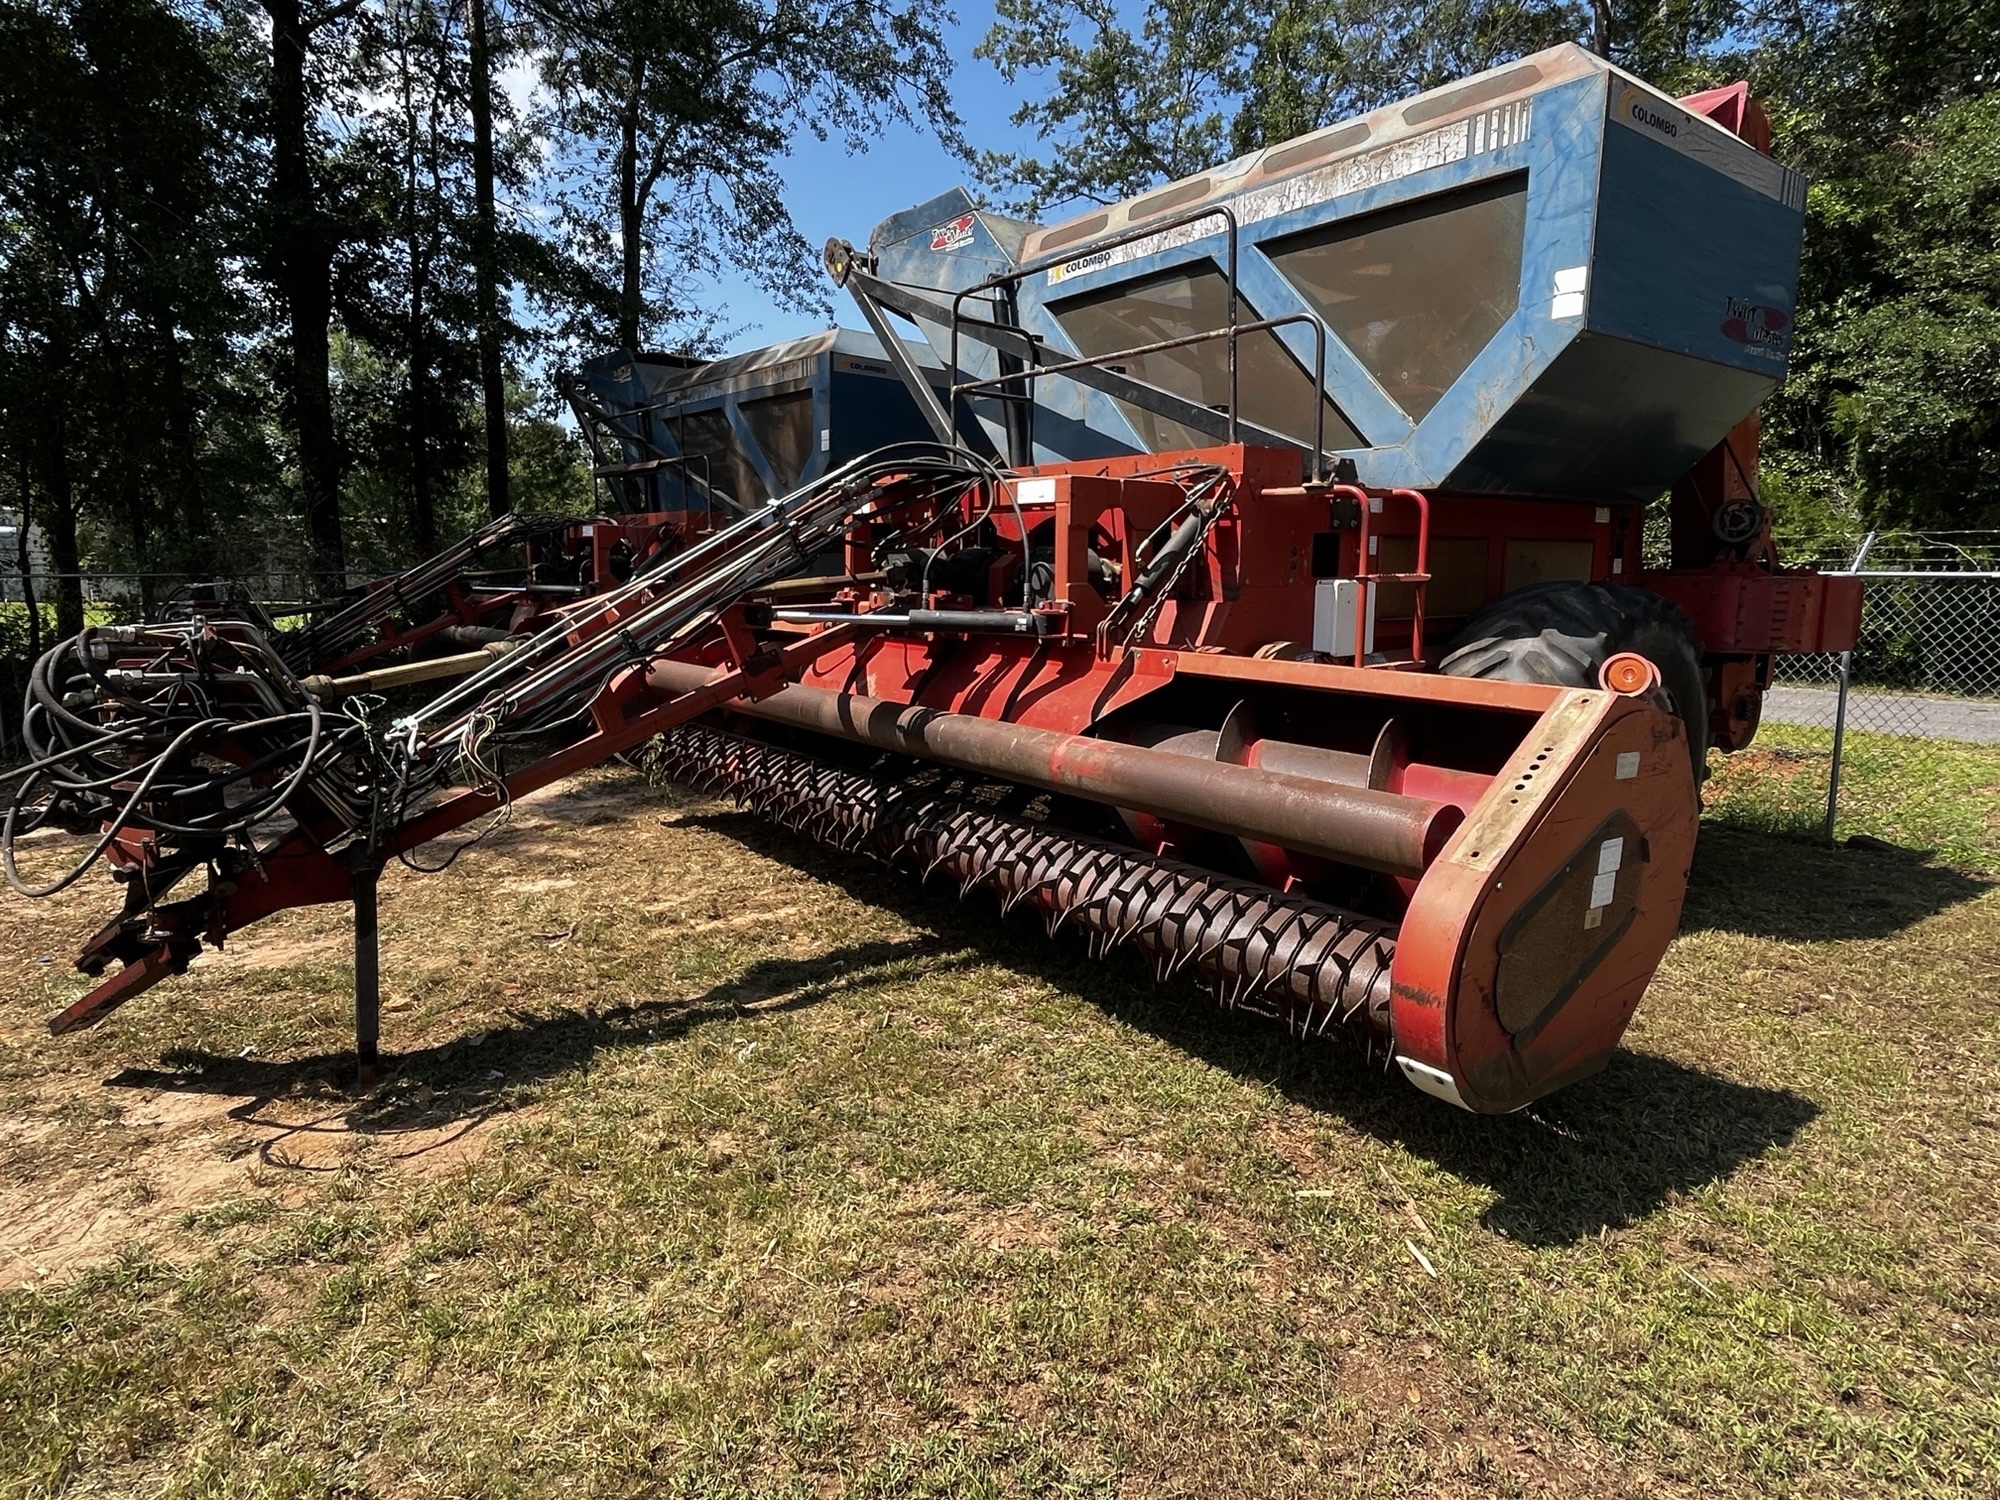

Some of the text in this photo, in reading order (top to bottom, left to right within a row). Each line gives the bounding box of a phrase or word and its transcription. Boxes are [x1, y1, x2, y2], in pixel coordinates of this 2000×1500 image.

[1632, 103, 1678, 138] COLOMBO
[1065, 250, 1111, 274] COLOMBO
[1726, 296, 1757, 322] Twin
